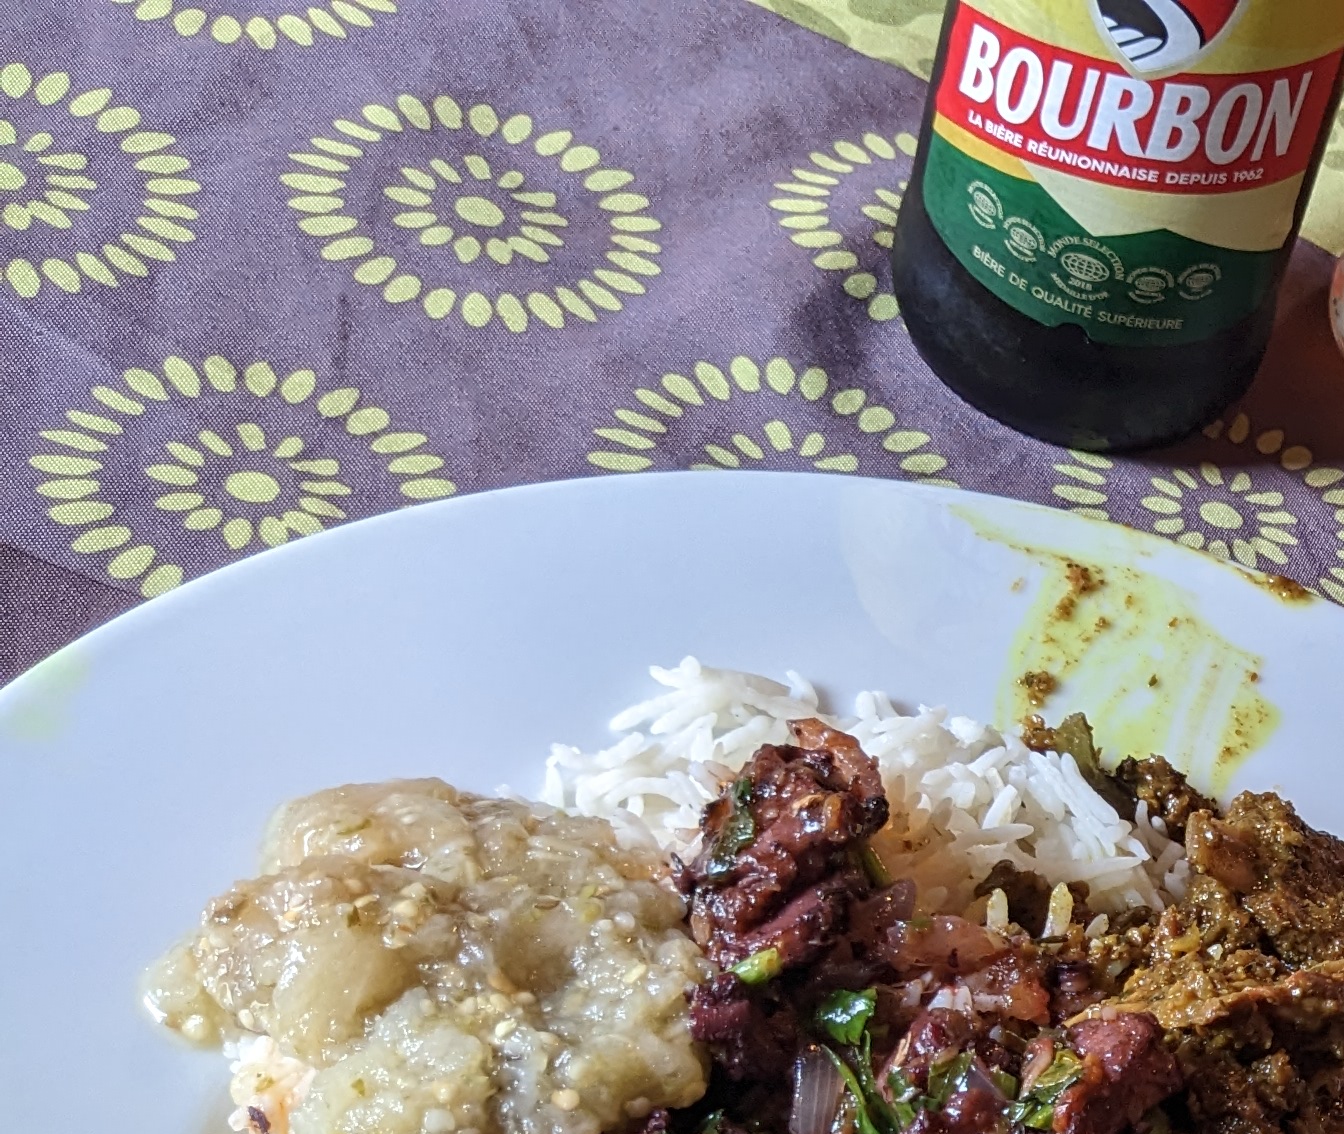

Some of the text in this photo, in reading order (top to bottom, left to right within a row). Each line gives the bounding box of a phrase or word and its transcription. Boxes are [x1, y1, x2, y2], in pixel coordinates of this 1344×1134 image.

[959, 23, 1312, 164] BOURBON
[968, 110, 1264, 185] LA BIÈRE RÉUNIONNAISE DEPUIS 1962
[972, 245, 1184, 331] BIÈRE DE QUALITÉ SUPÉRIEURE
[1048, 236, 1080, 258] MONDE
[1083, 237, 1125, 281] SELECTION
